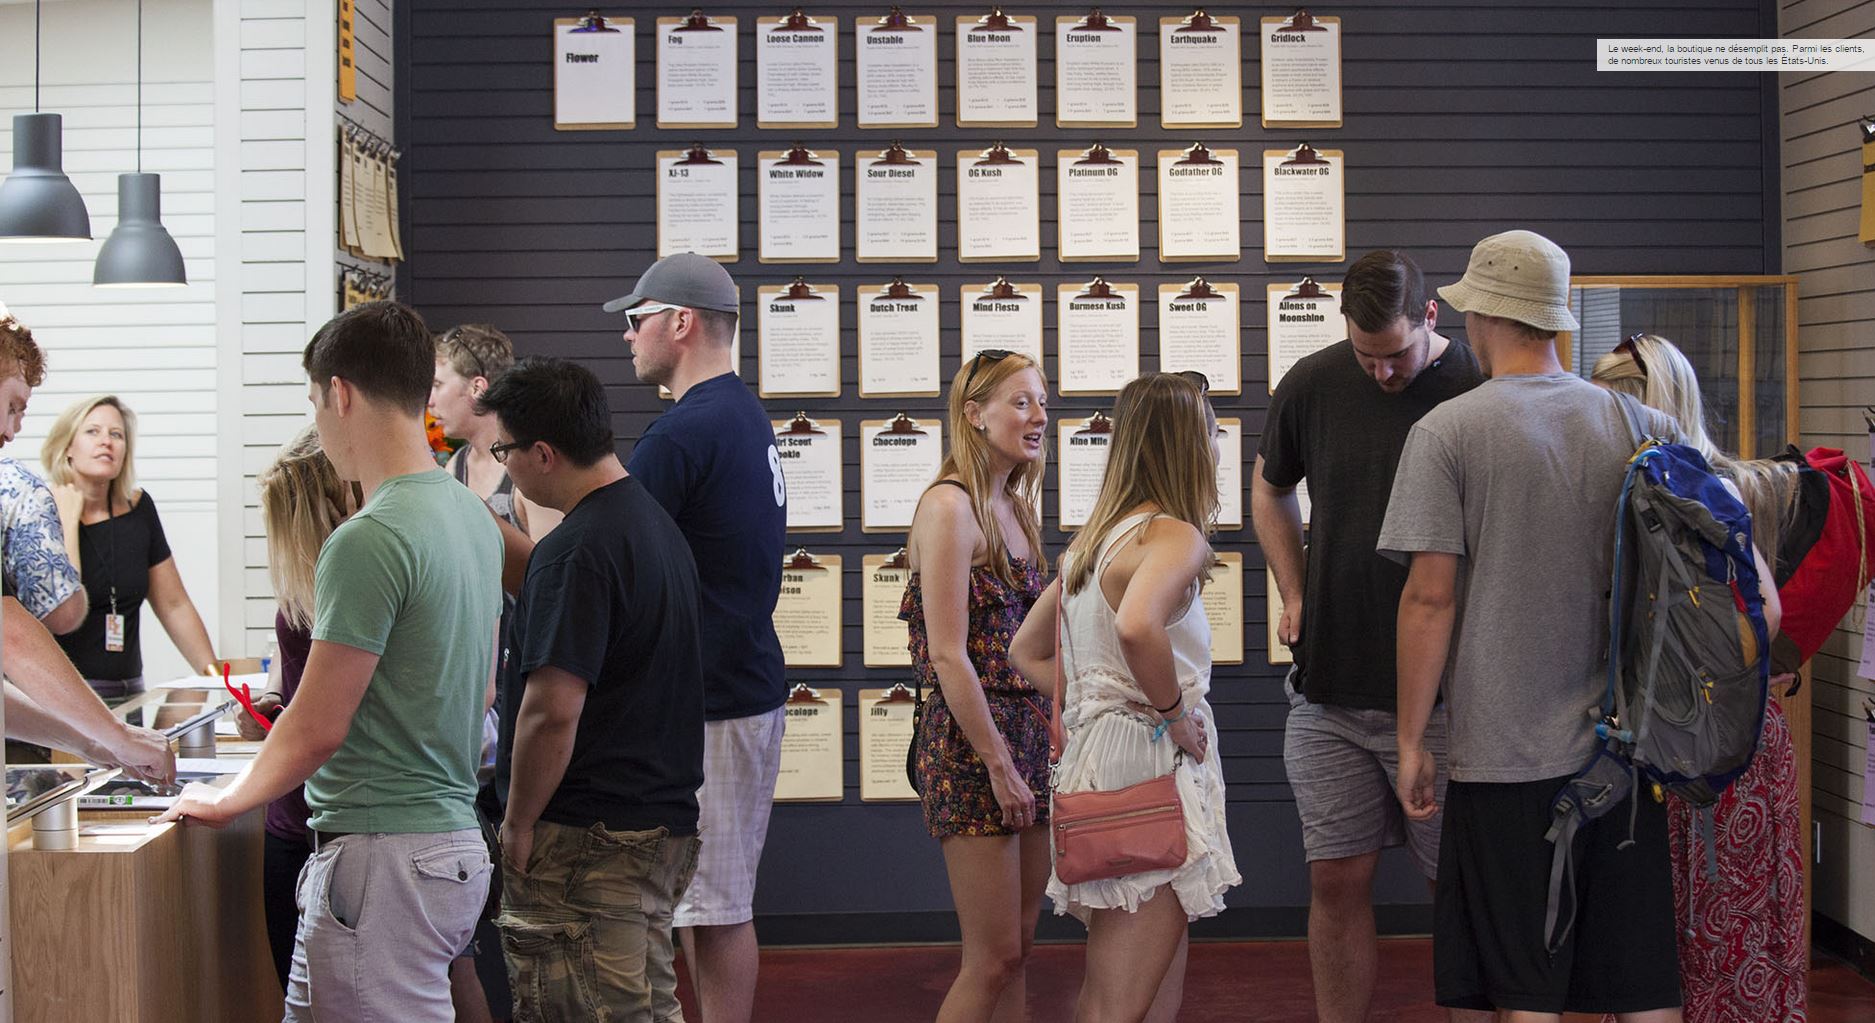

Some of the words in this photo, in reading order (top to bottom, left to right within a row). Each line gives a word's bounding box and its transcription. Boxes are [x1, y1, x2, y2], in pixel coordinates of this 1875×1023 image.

[668, 35, 682, 44] Fog
[766, 34, 791, 44] Loose
[793, 34, 824, 43] Cannon
[867, 36, 903, 44] Unstable
[968, 34, 986, 42] Blue
[988, 34, 1010, 42] Moon
[1066, 34, 1101, 44] Eruption
[1170, 35, 1217, 45] Earthquake
[1270, 33, 1305, 43] Gridlock
[566, 53, 599, 63] Flower
[769, 170, 793, 178] White
[796, 170, 823, 178] Widow
[868, 169, 886, 177] Sour
[889, 169, 914, 177] Diesel
[969, 169, 979, 177] OG
[1107, 168, 1118, 176] OG
[1169, 168, 1209, 177] Godfather
[1211, 167, 1222, 176] OG
[1274, 168, 1317, 176] Blackwater
[1319, 167, 1330, 176] OG
[770, 304, 795, 312] Skunk
[870, 304, 894, 312] Dutch
[896, 303, 918, 312] Treat
[973, 303, 993, 311] Mind
[995, 303, 1019, 311] Fiesta
[1106, 302, 1125, 310] Kush
[1169, 303, 1194, 311] Sweet
[1196, 302, 1206, 311] OG
[1279, 302, 1304, 310] Aliens
[1306, 302, 1316, 310] on
[1280, 314, 1324, 322] Moonshine
[788, 438, 812, 446] Scout
[873, 437, 917, 446] Chocolope
[1070, 437, 1088, 445] Nine
[1090, 437, 1107, 445] Mile
[779, 450, 800, 458] ookie
[783, 574, 803, 582] rban
[874, 574, 899, 582] Skunk
[785, 708, 818, 717] ocolope
[870, 708, 888, 717] Jilly
